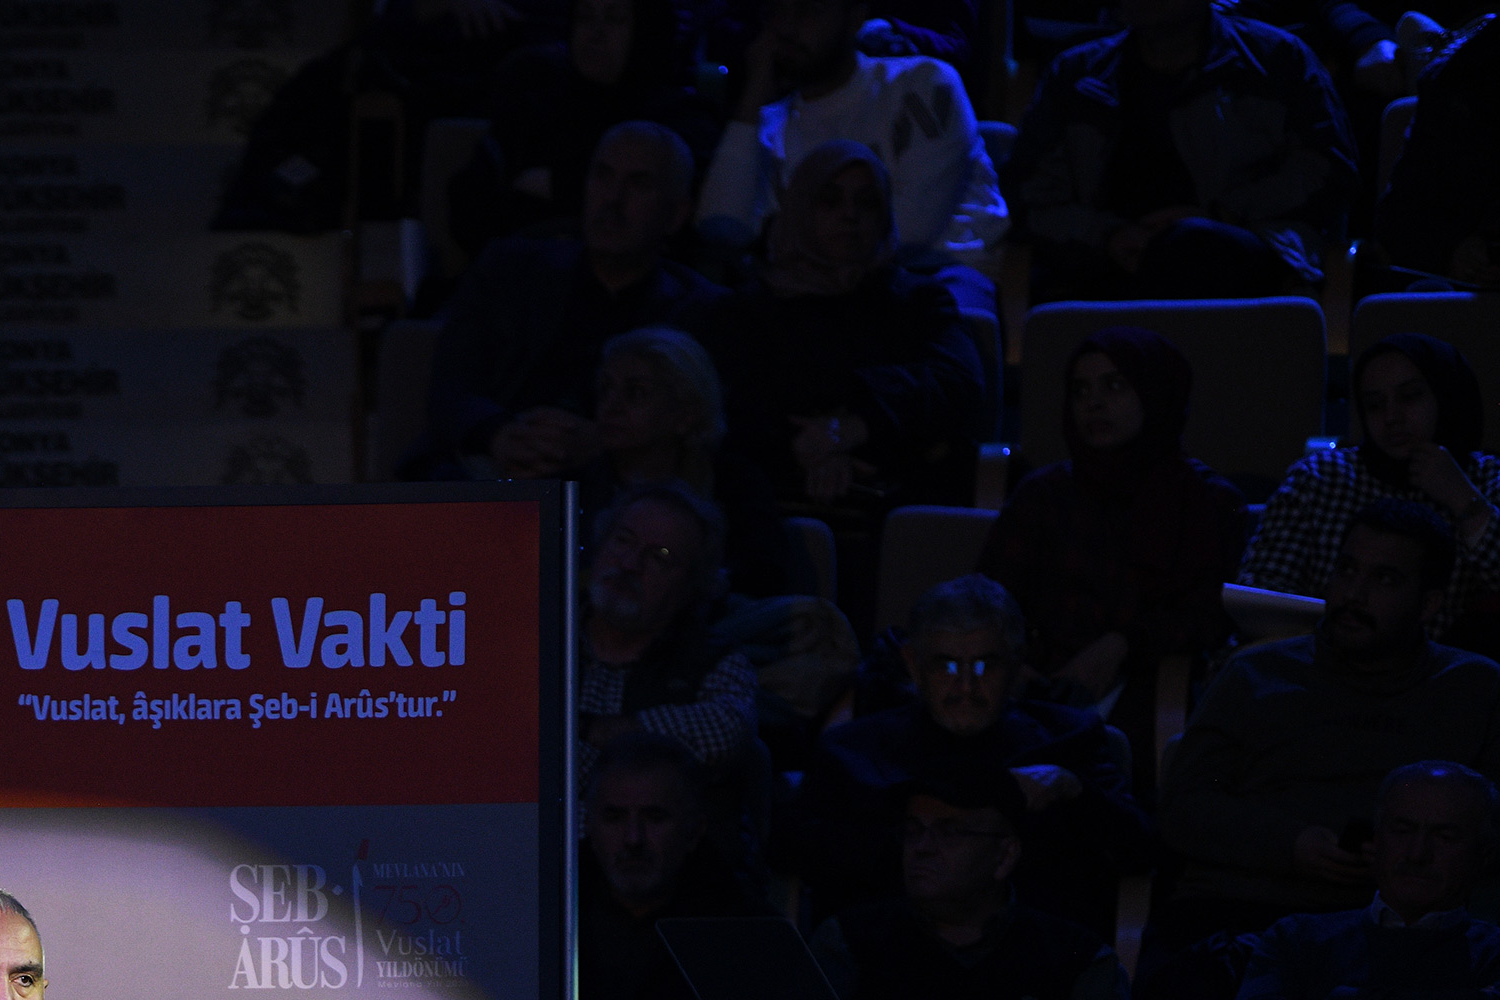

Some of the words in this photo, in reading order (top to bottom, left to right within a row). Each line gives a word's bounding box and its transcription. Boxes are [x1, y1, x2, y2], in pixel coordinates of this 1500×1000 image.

[6, 594, 251, 671] Vuslat
[271, 590, 467, 669] Vakti
[132, 690, 242, 729] âşıklara
[249, 690, 318, 729] Şeb-i
[376, 928, 463, 956] Vuslat
